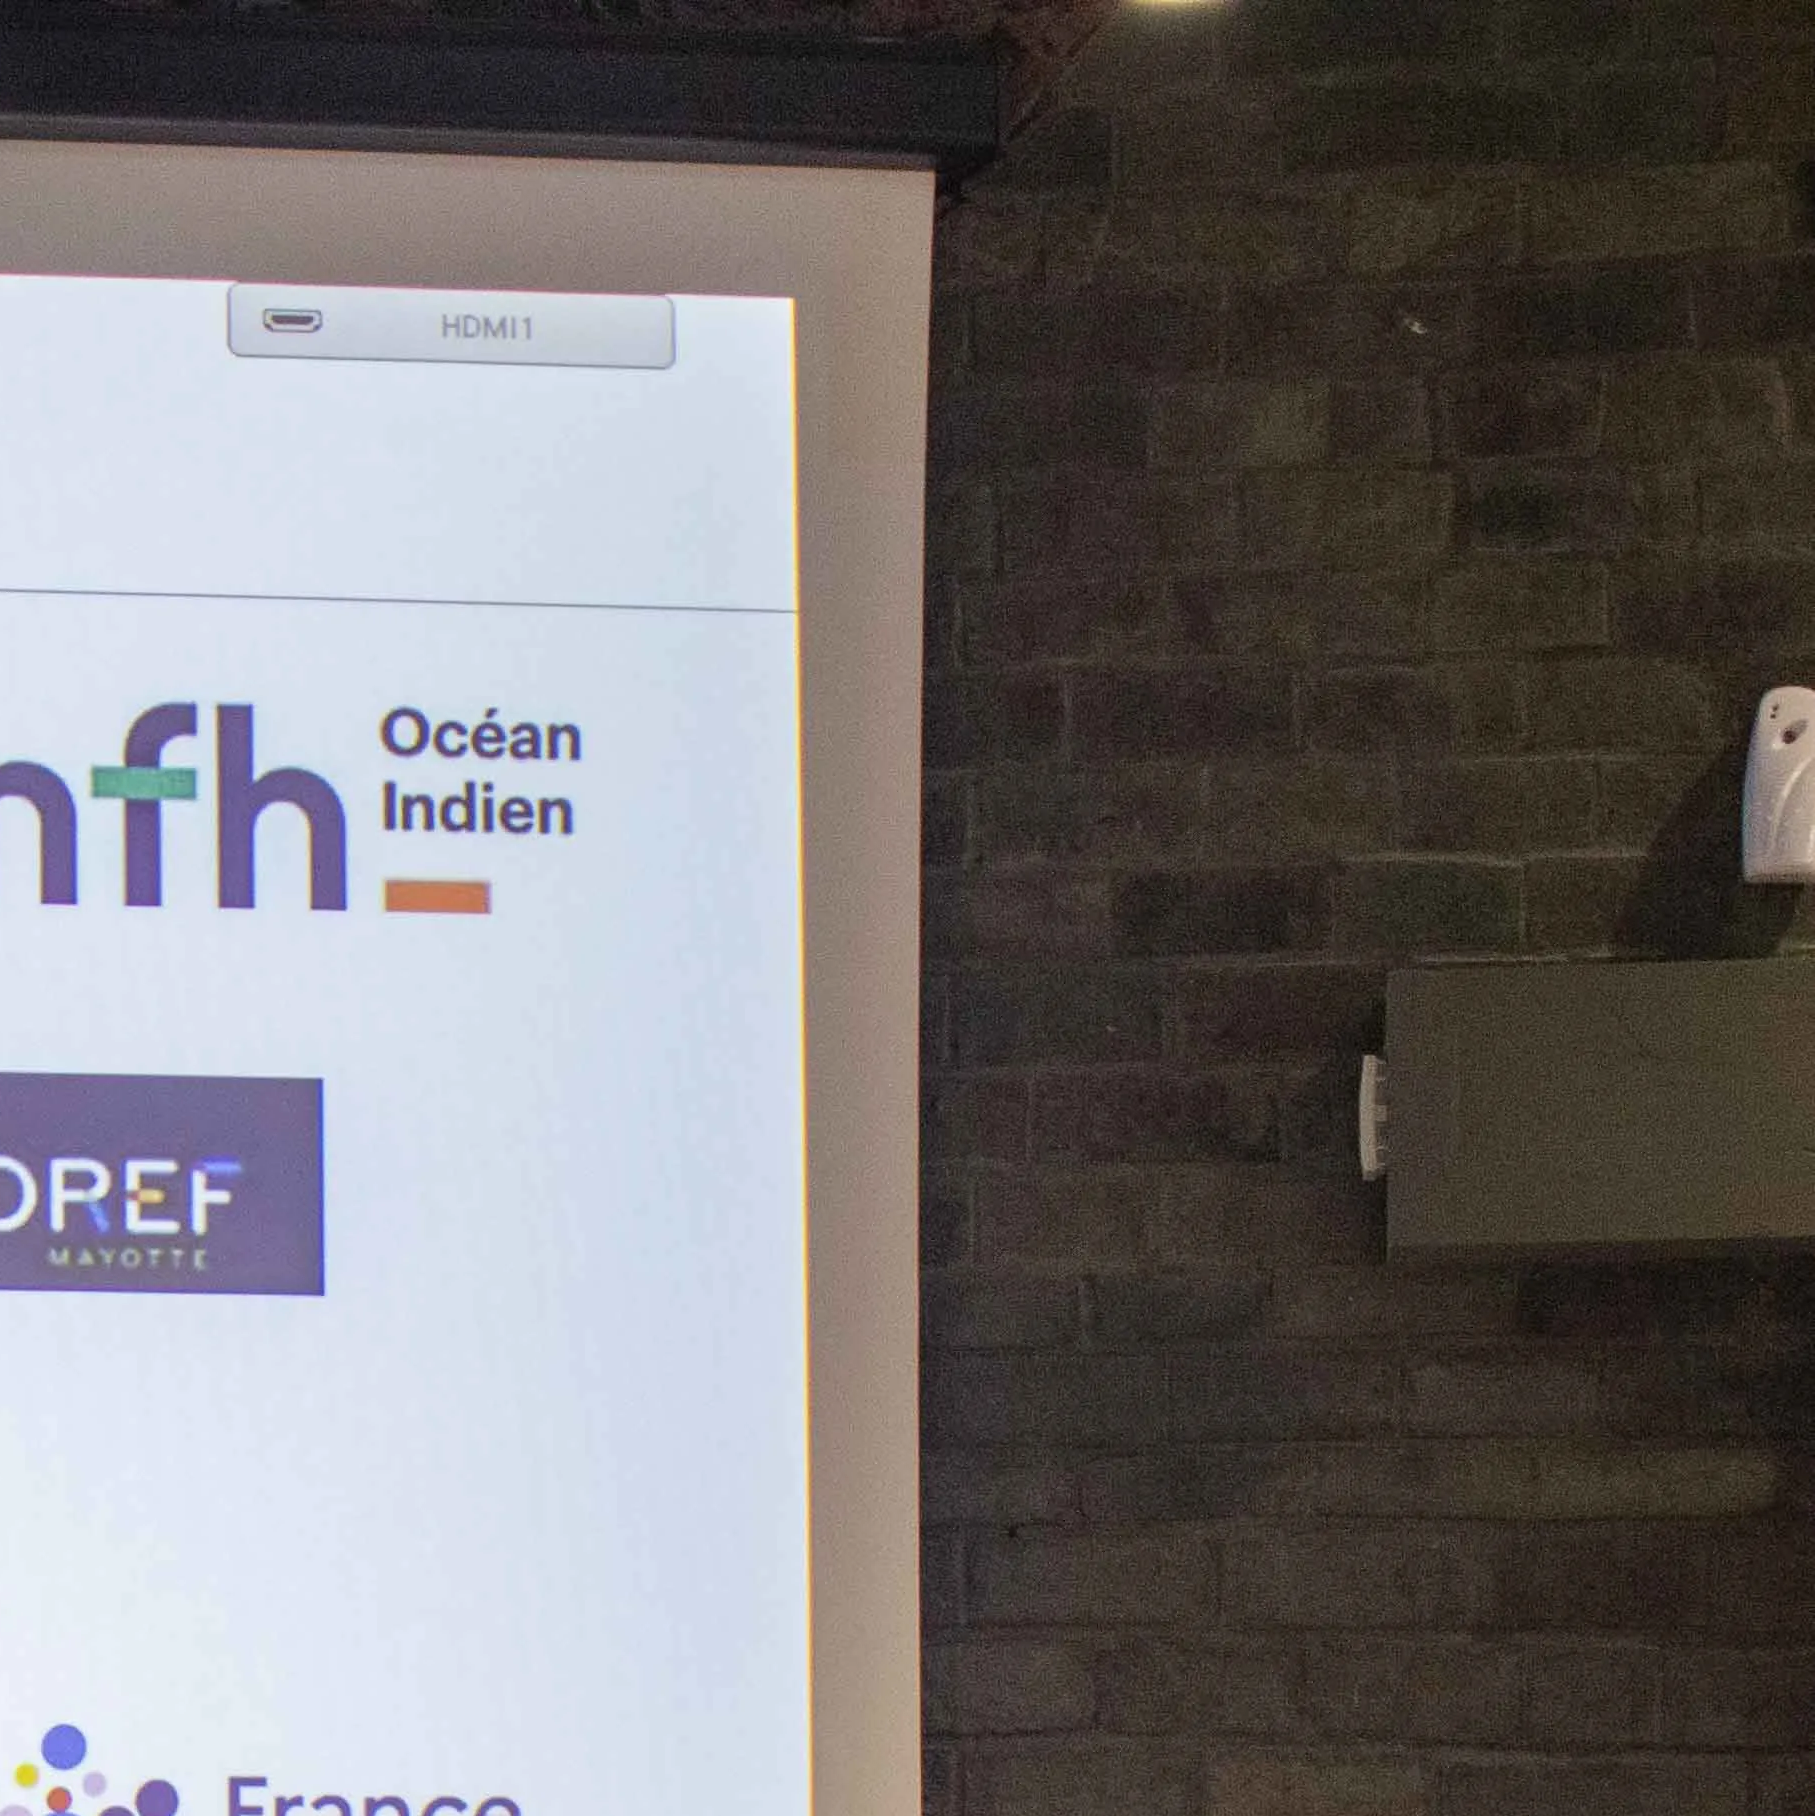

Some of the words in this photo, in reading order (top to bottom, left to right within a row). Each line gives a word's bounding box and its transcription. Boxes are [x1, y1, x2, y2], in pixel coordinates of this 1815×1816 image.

[442, 314, 531, 340] HDMI1
[381, 707, 581, 760] Océan
[384, 781, 573, 835] Indien
[47, 1246, 207, 1271] MAYOTTE
